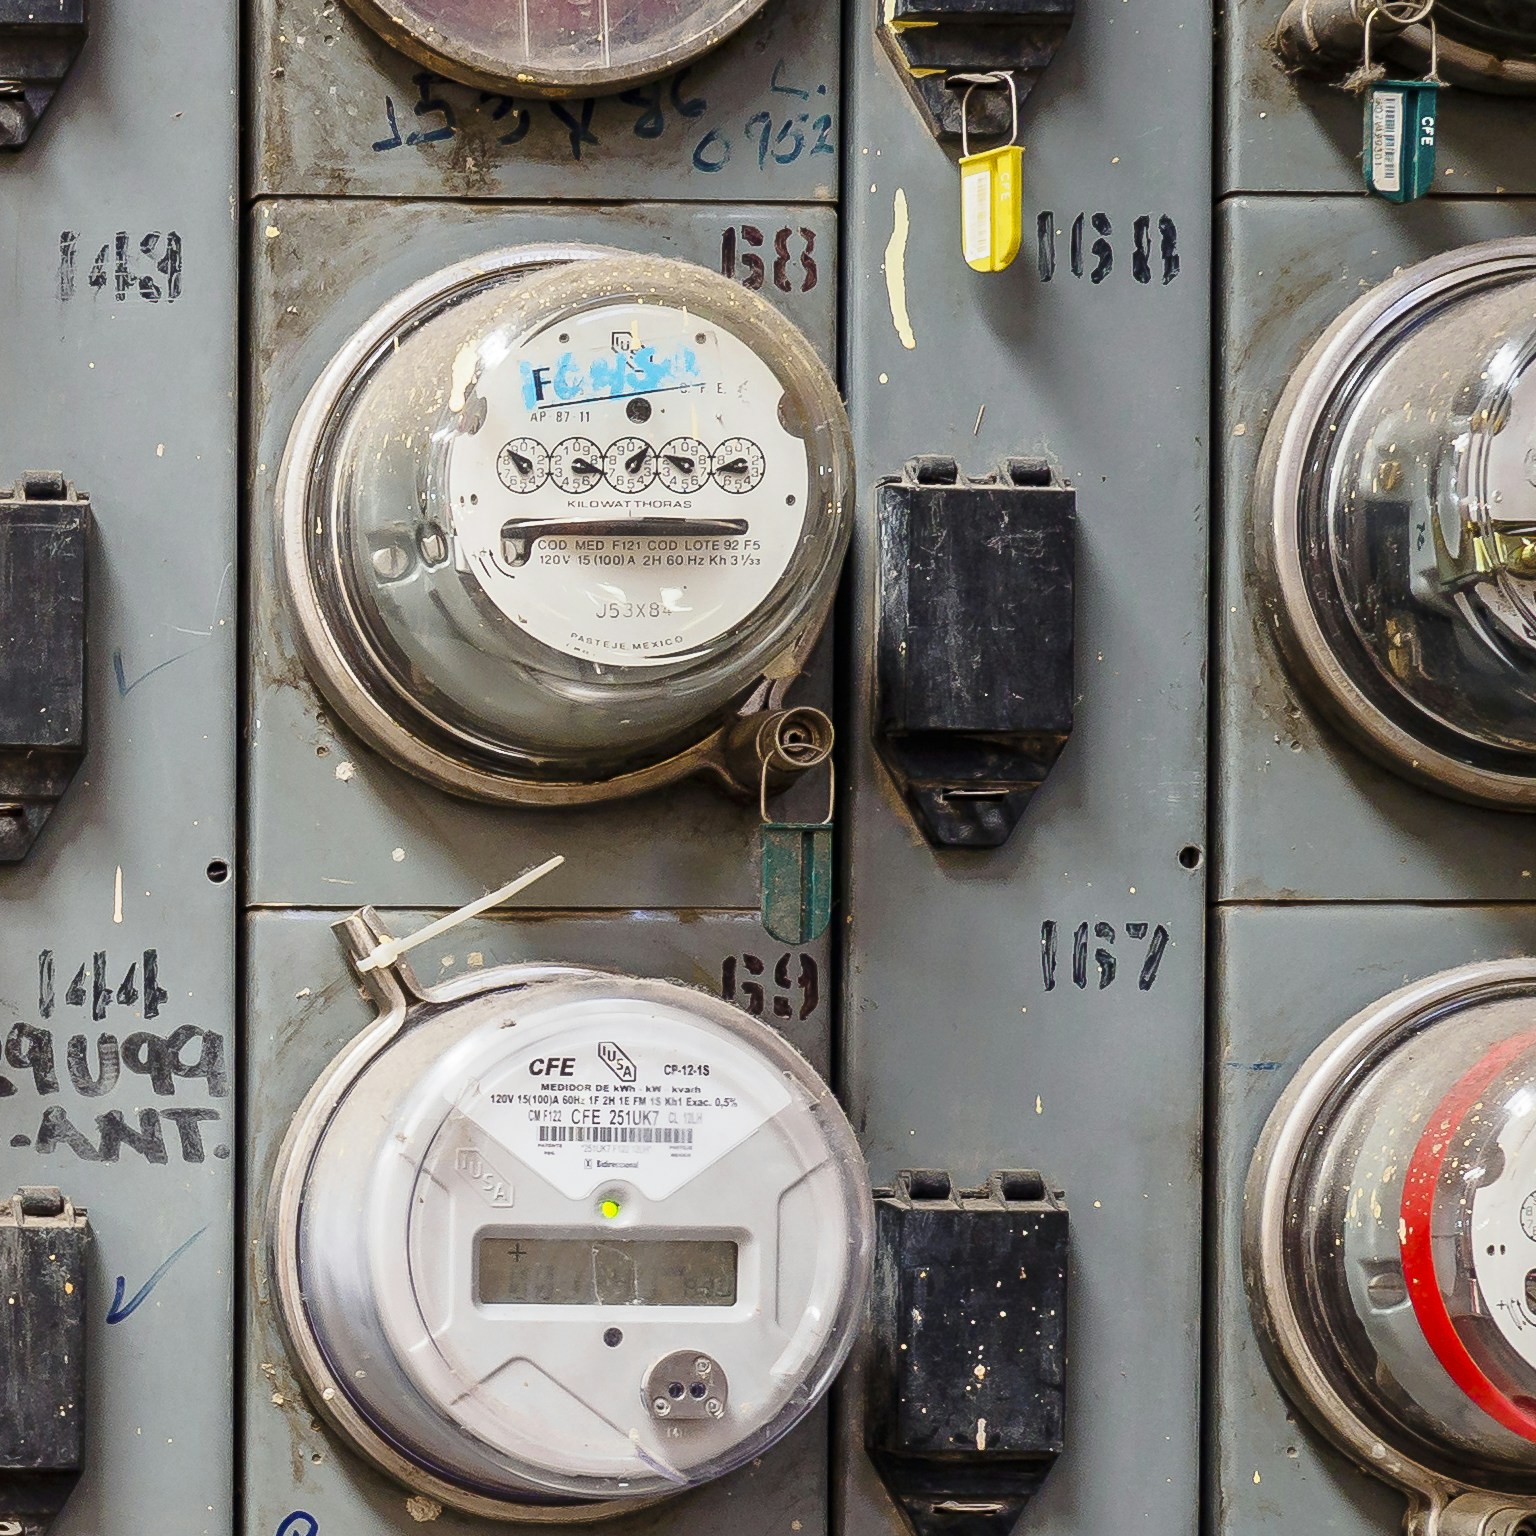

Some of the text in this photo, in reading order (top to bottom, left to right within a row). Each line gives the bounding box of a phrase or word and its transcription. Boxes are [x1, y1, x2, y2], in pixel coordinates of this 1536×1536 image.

[1421, 114, 1434, 147] CFE
[721, 224, 819, 293] 68
[567, 500, 692, 509] KILOWATTHORAS
[537, 539, 568, 550] COD
[575, 539, 605, 551] MED
[612, 540, 641, 551] F121
[647, 540, 678, 551] COD
[684, 540, 720, 551] LOTE
[642, 555, 662, 565] 2H
[1040, 919, 1169, 992] 167
[723, 953, 819, 1021] 69
[528, 1057, 576, 1076] CFE
[600, 1044, 634, 1079] IUSA
[541, 1084, 592, 1092] MEDIDOR
[490, 1094, 514, 1104] 120V
[528, 1111, 541, 1122] CM
[571, 1109, 600, 1125] CFE
[609, 1110, 660, 1126] 251UK7
